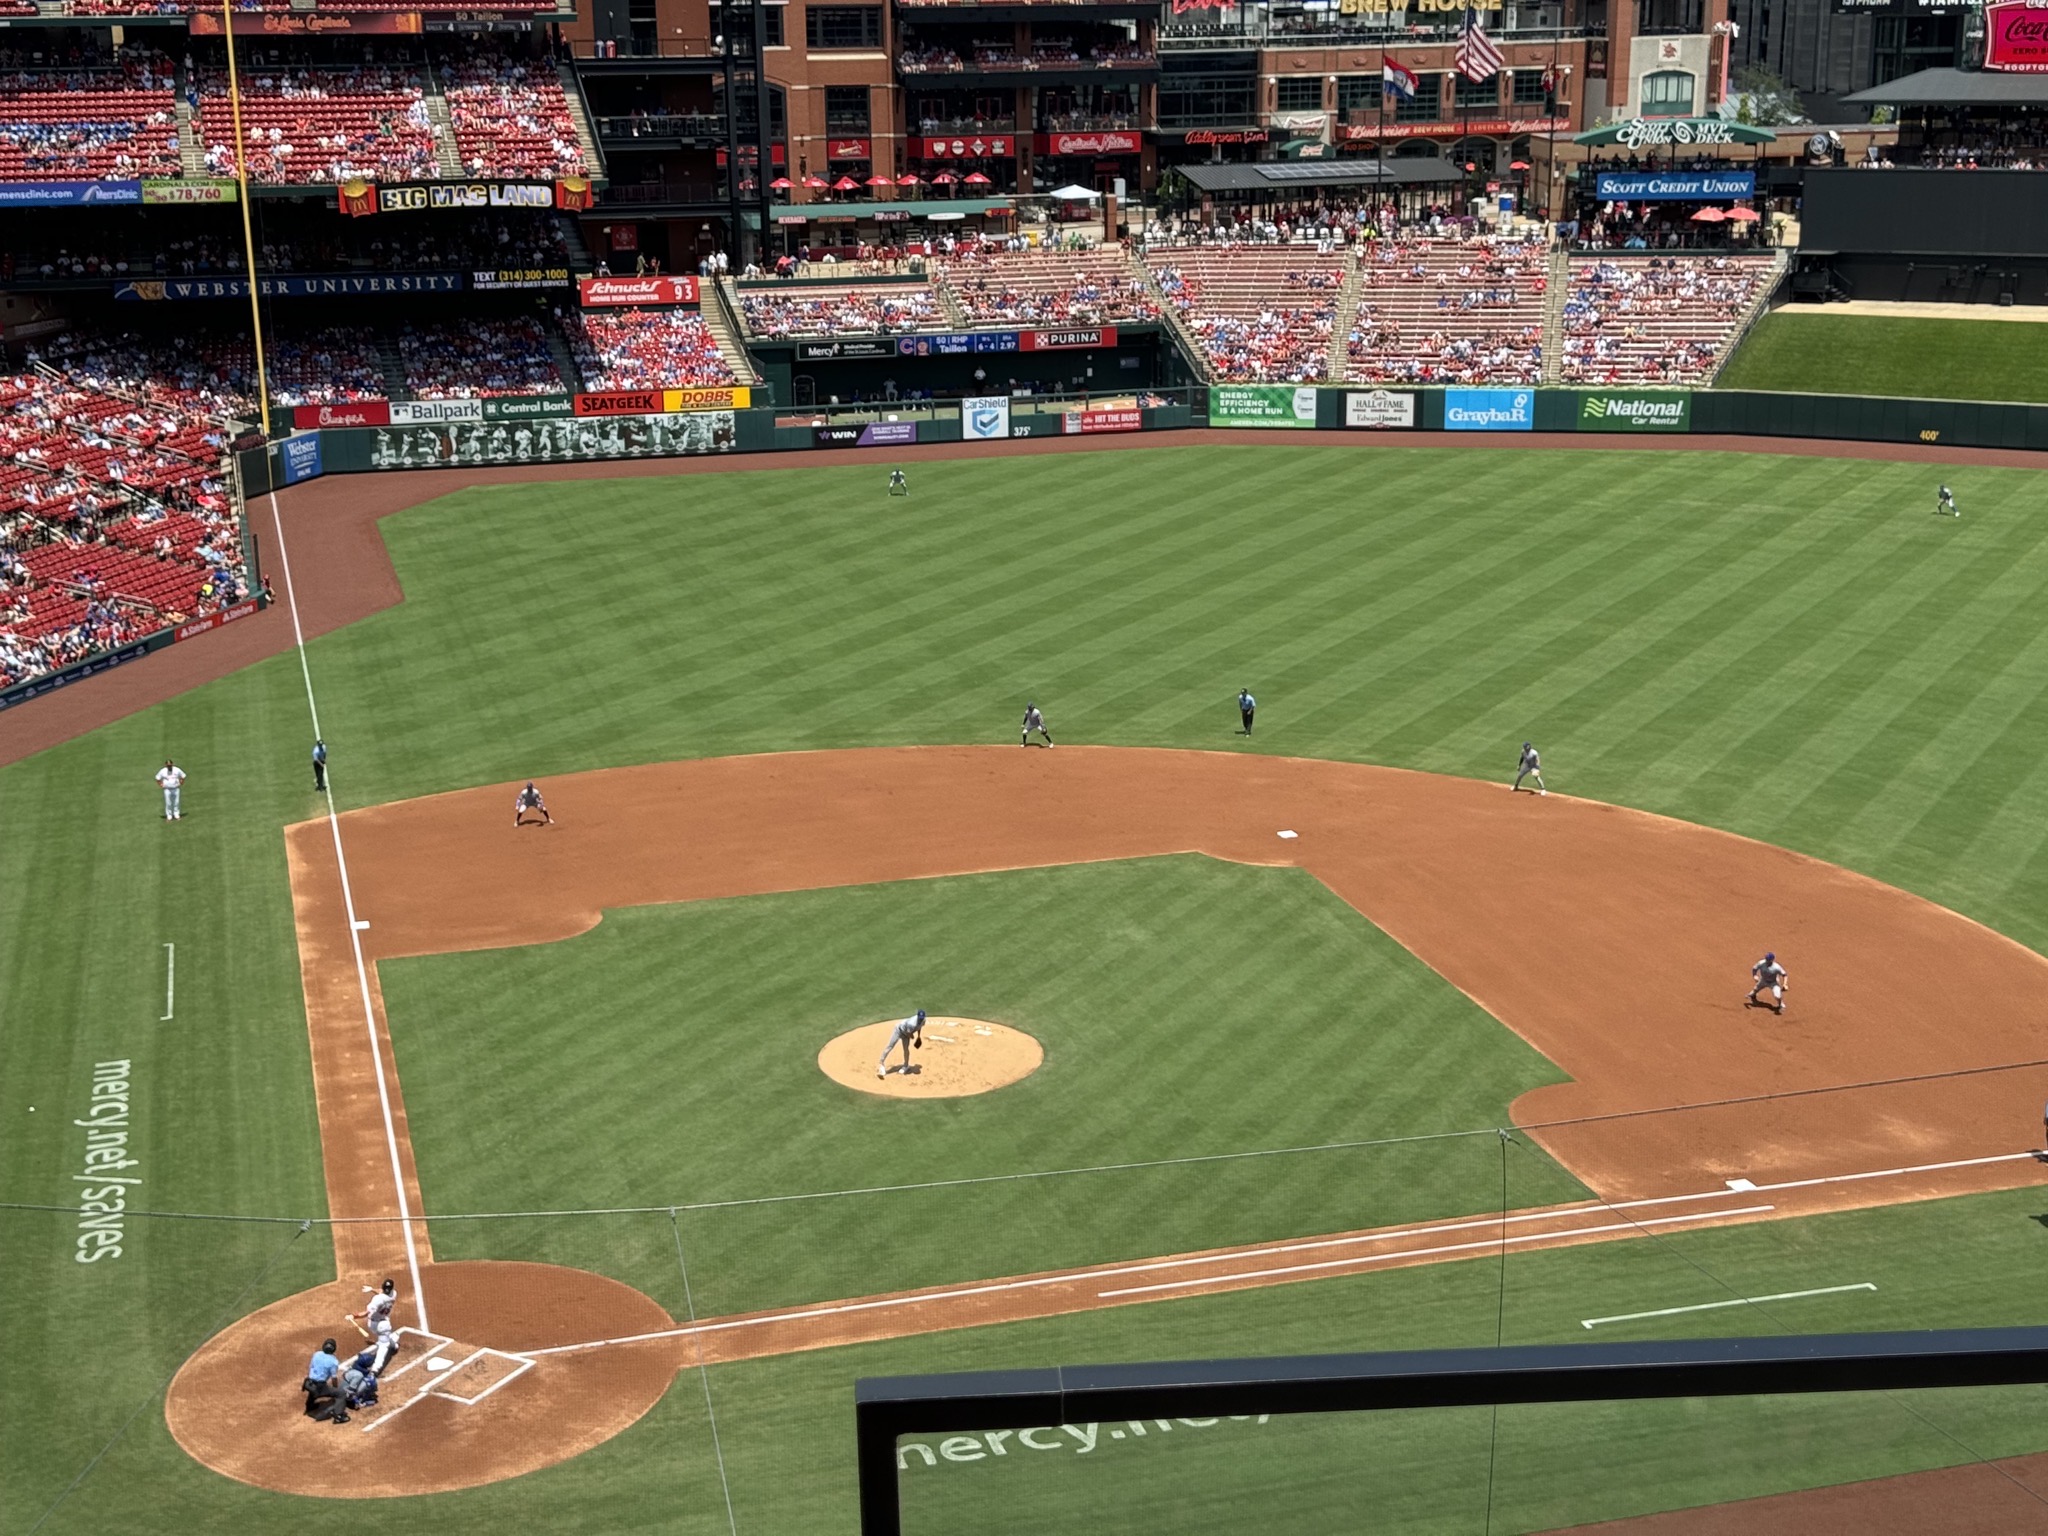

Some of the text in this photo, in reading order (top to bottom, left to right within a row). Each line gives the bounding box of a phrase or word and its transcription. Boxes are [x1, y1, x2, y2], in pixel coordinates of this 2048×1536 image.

[1341, 0, 1503, 14] BREW HOUSE
[306, 14, 351, 31] Cardinals
[456, 12, 504, 21] 50 Taillon
[447, 22, 455, 32] 4
[487, 22, 494, 32] 7
[520, 22, 532, 31] 11
[1348, 125, 1412, 139] Budweiser
[1697, 123, 1729, 134] MVP
[1185, 130, 1218, 146] Bally
[1695, 132, 1734, 144] DECK
[1601, 178, 1749, 193] SCOTT CREDIT UNION
[169, 188, 221, 202] $78,760
[380, 184, 552, 211] BIG MAC LAND
[473, 269, 568, 281] TEXT (314) 300-1000
[175, 275, 456, 297] WEBSTER UNIVERSITY
[587, 281, 662, 294] Schnucks
[627, 293, 659, 301] COUNTER
[935, 335, 969, 344] 50 RHP
[1051, 333, 1098, 344] PURINA
[940, 344, 968, 353] Taillon
[1000, 341, 1016, 350] 2.97
[808, 347, 834, 357] Mercy
[682, 390, 734, 403] DOBBS
[502, 400, 572, 413] Central Bank
[582, 395, 654, 412] SEATGEEK
[964, 398, 1007, 409] CarShield
[1356, 400, 1376, 408] HALL
[412, 404, 480, 420] Ballpark
[1357, 414, 1402, 422] Edward Jones
[1095, 415, 1106, 423] HIT
[1107, 414, 1120, 422] THE
[1631, 416, 1678, 425] Car Rental
[831, 430, 857, 439] WIN
[73, 1059, 142, 1263] mercy.net/saves
